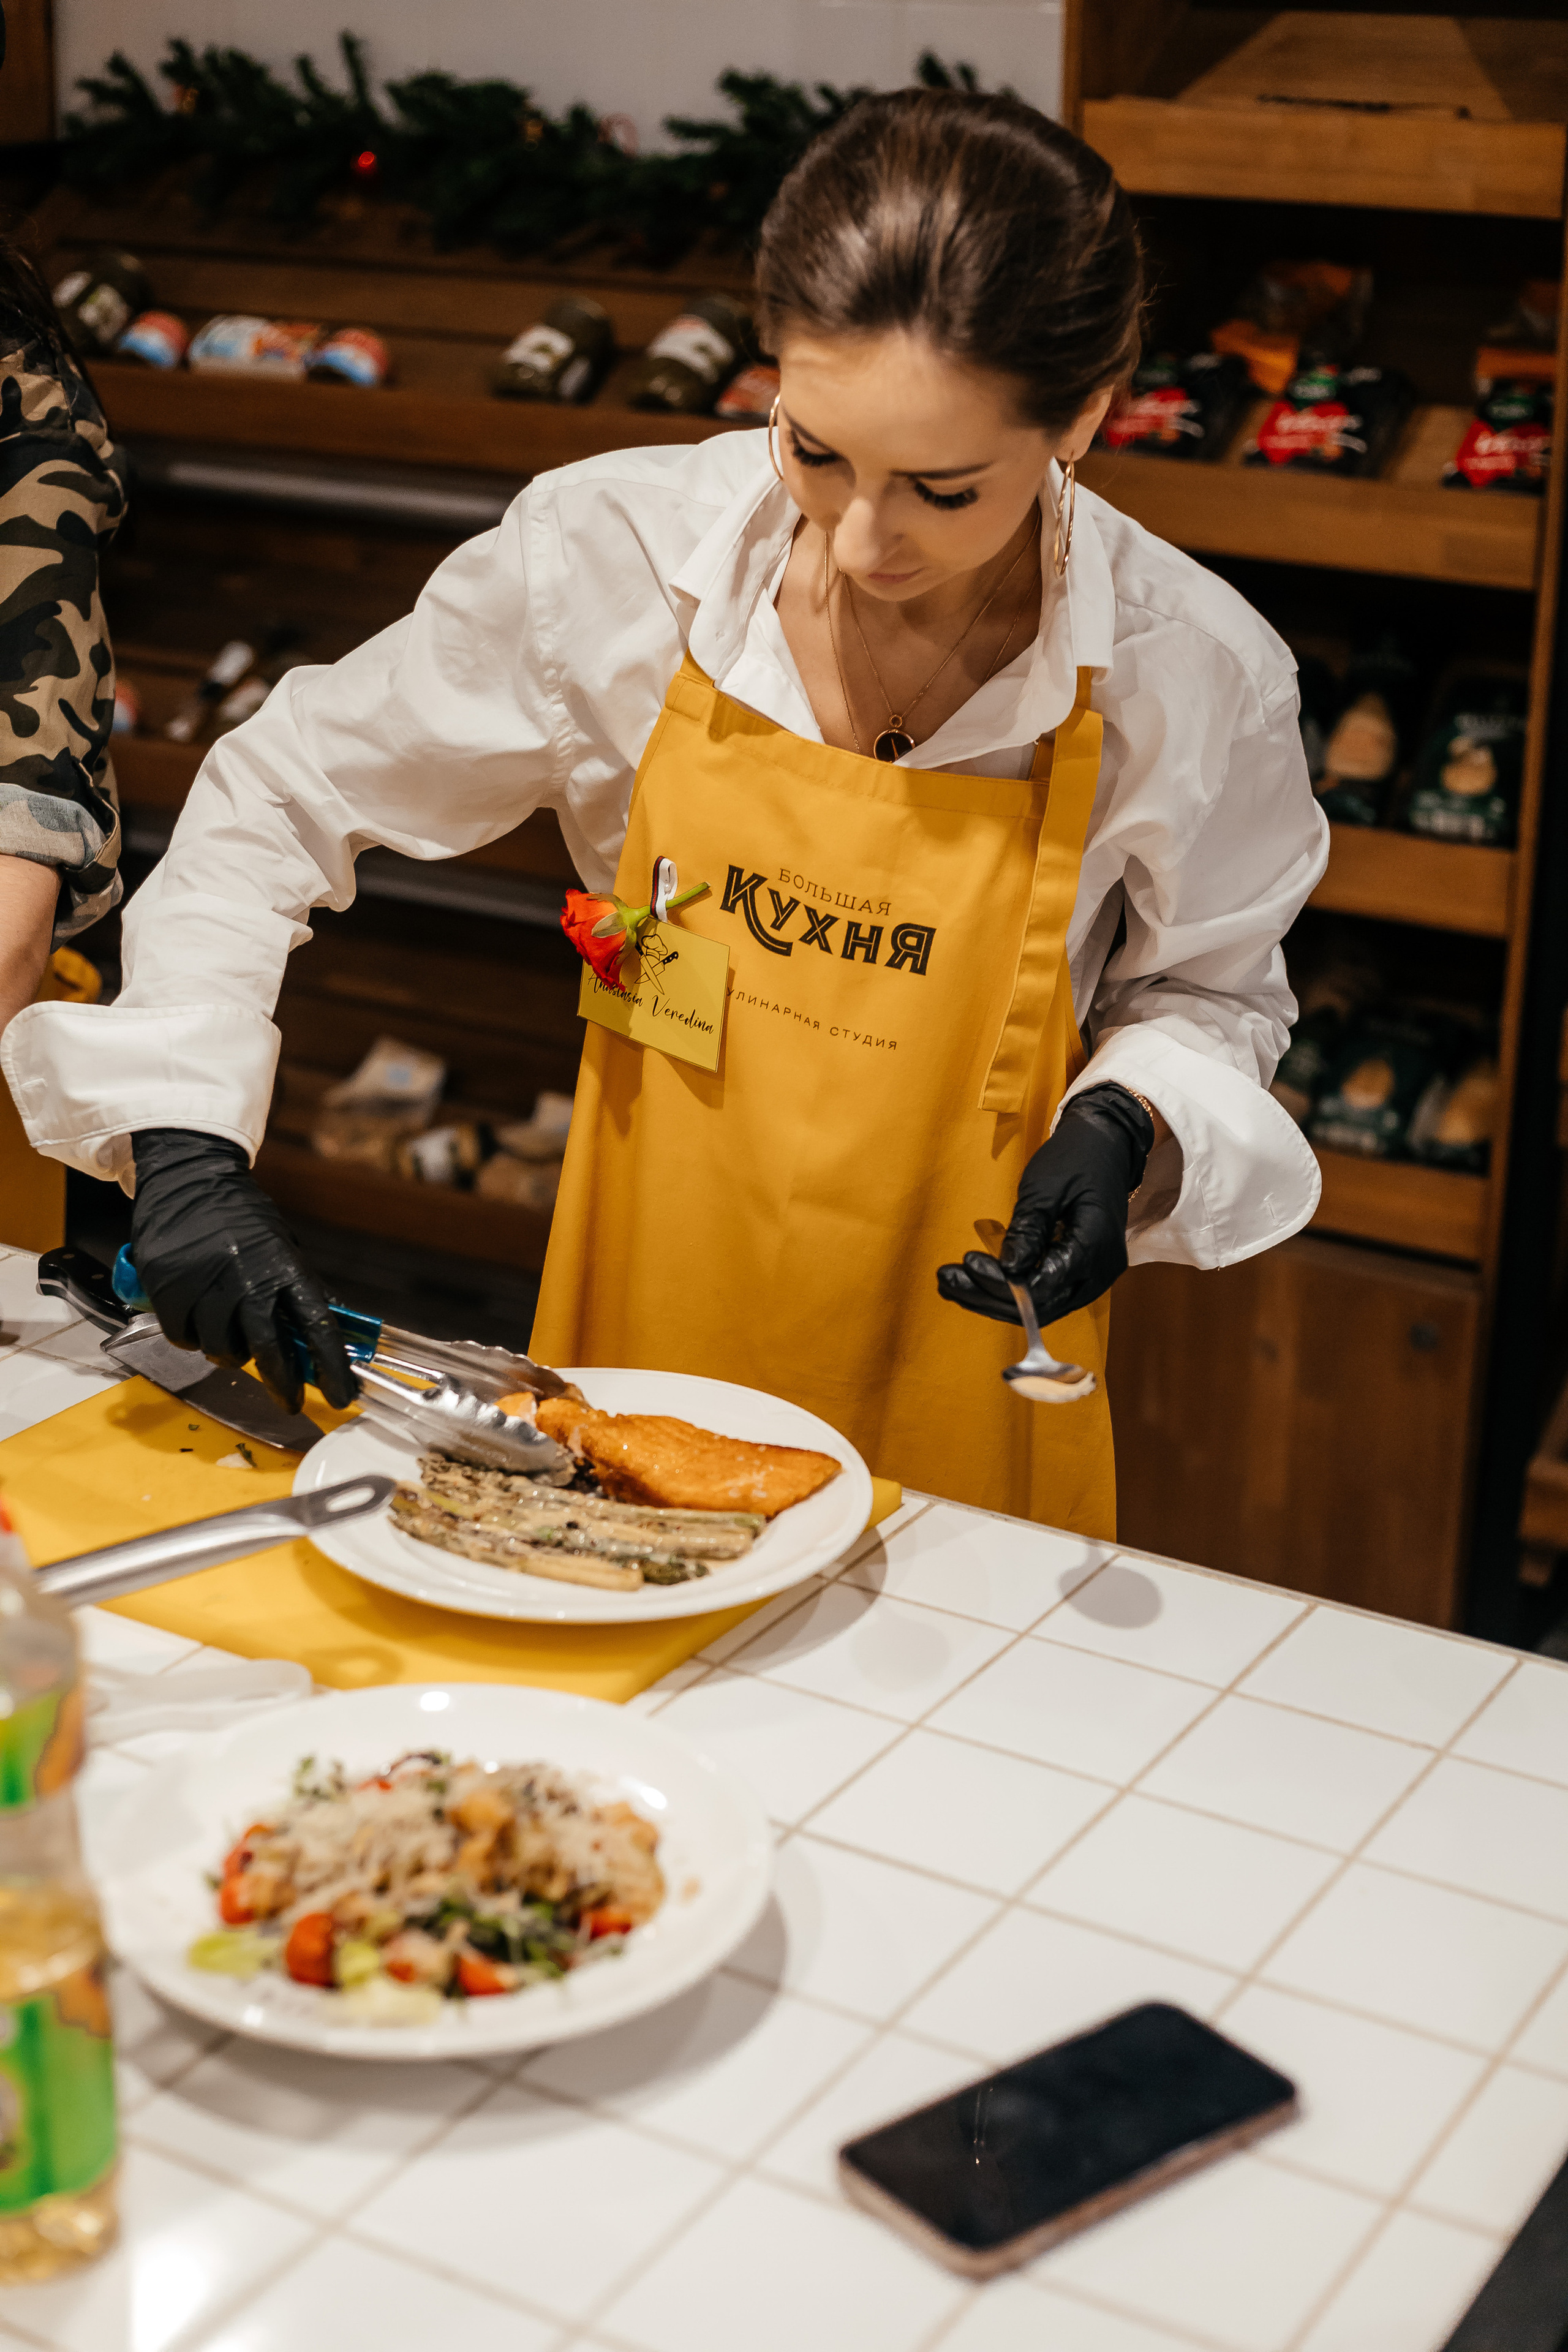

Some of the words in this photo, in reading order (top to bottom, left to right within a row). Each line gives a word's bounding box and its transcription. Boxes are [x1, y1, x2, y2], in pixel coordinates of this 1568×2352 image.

[778, 868, 892, 916] БОЛЬШАЯ
[719, 864, 937, 976] КУХНЯ
[651, 994, 715, 1035] Veredina
[726, 987, 820, 1030] УЛИНАРНАЯ
[829, 1027, 898, 1050] СТУДИЯ
